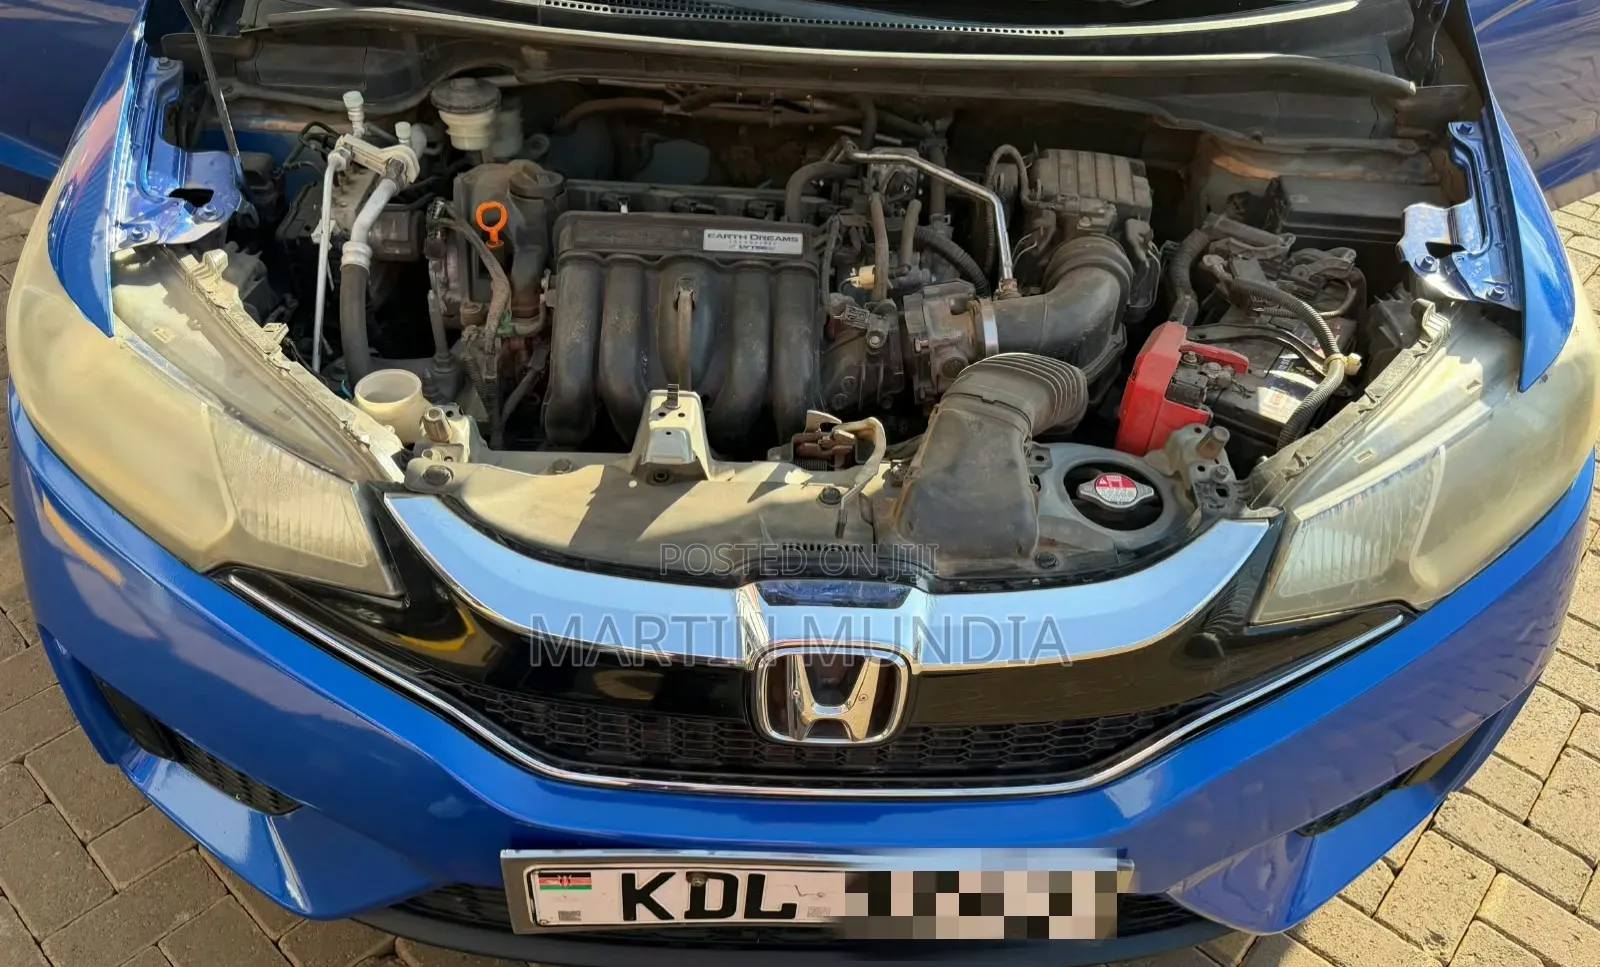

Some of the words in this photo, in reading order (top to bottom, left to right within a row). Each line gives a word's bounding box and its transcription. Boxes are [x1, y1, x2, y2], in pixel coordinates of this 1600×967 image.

[707, 232, 748, 240] EARTH
[749, 233, 799, 242] DREAMS
[620, 871, 798, 922] KDL
